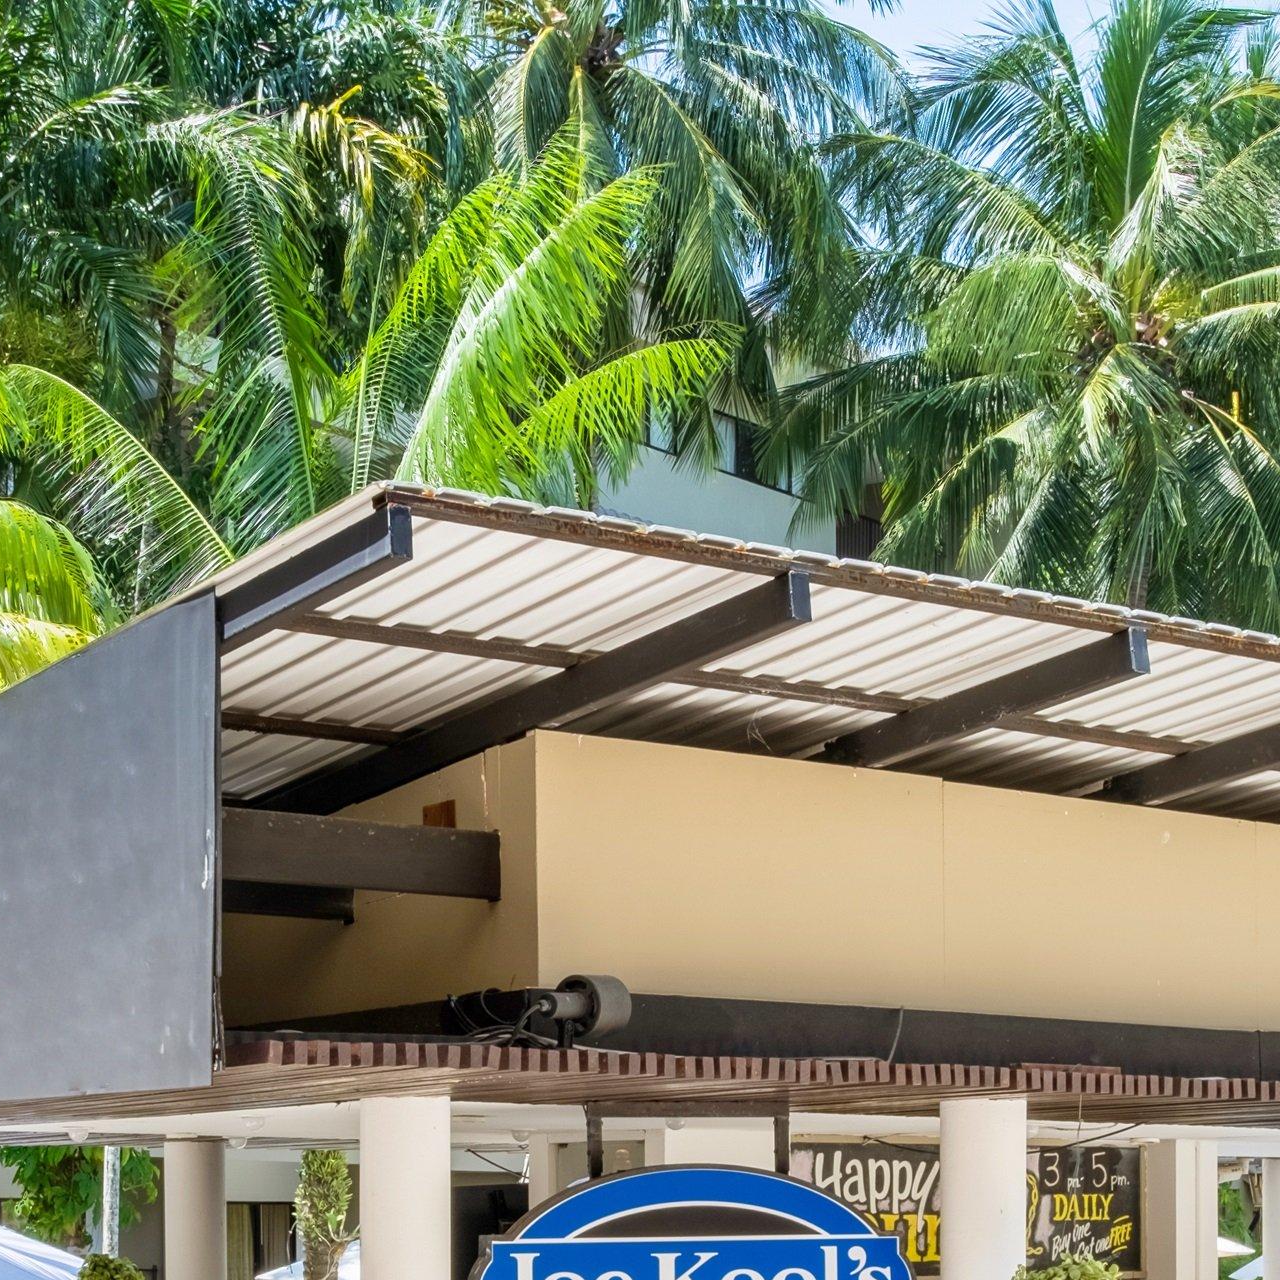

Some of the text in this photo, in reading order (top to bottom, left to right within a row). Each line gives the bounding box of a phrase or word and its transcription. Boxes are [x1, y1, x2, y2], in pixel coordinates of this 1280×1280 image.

[1043, 1152, 1060, 1187] 3
[1091, 1151, 1108, 1188] 5
[815, 1150, 940, 1233] Happy
[1053, 1193, 1114, 1221] DAILY
[1051, 1221, 1092, 1261] Buy one
[1109, 1222, 1132, 1248] FREE
